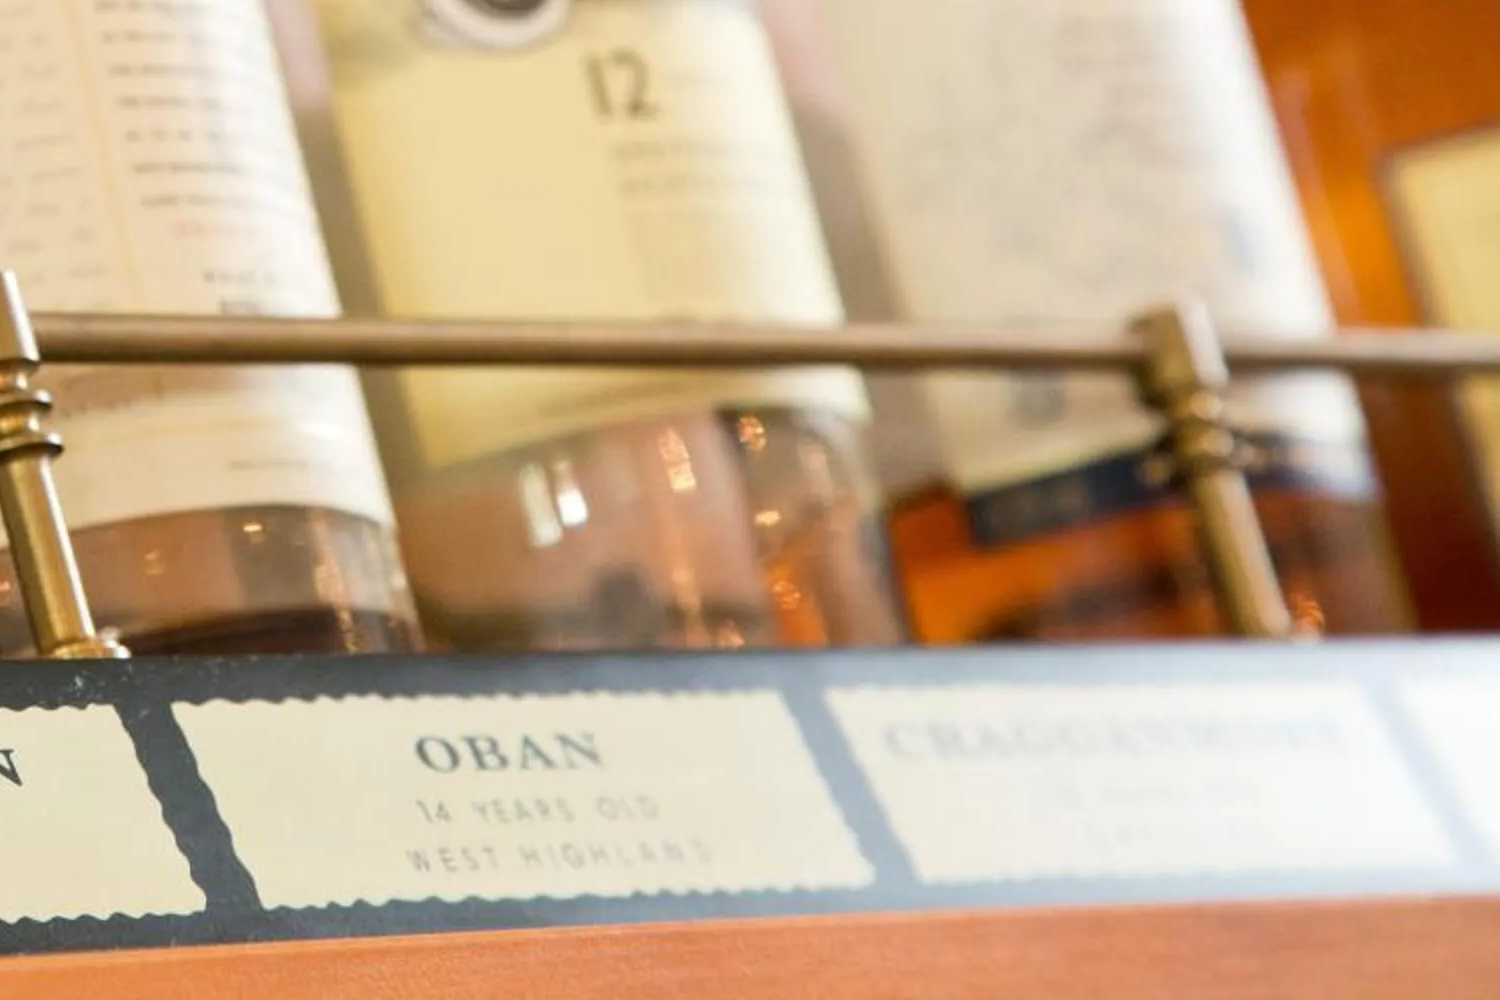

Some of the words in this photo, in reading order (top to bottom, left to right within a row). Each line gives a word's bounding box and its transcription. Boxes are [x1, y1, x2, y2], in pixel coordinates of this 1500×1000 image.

[583, 46, 660, 123] 12
[414, 729, 606, 774] OBAN
[415, 798, 452, 825] 14
[471, 797, 578, 825] YEARS
[595, 794, 662, 821] OLD
[404, 845, 501, 874] WEST
[518, 836, 714, 871] HIGHLAND
